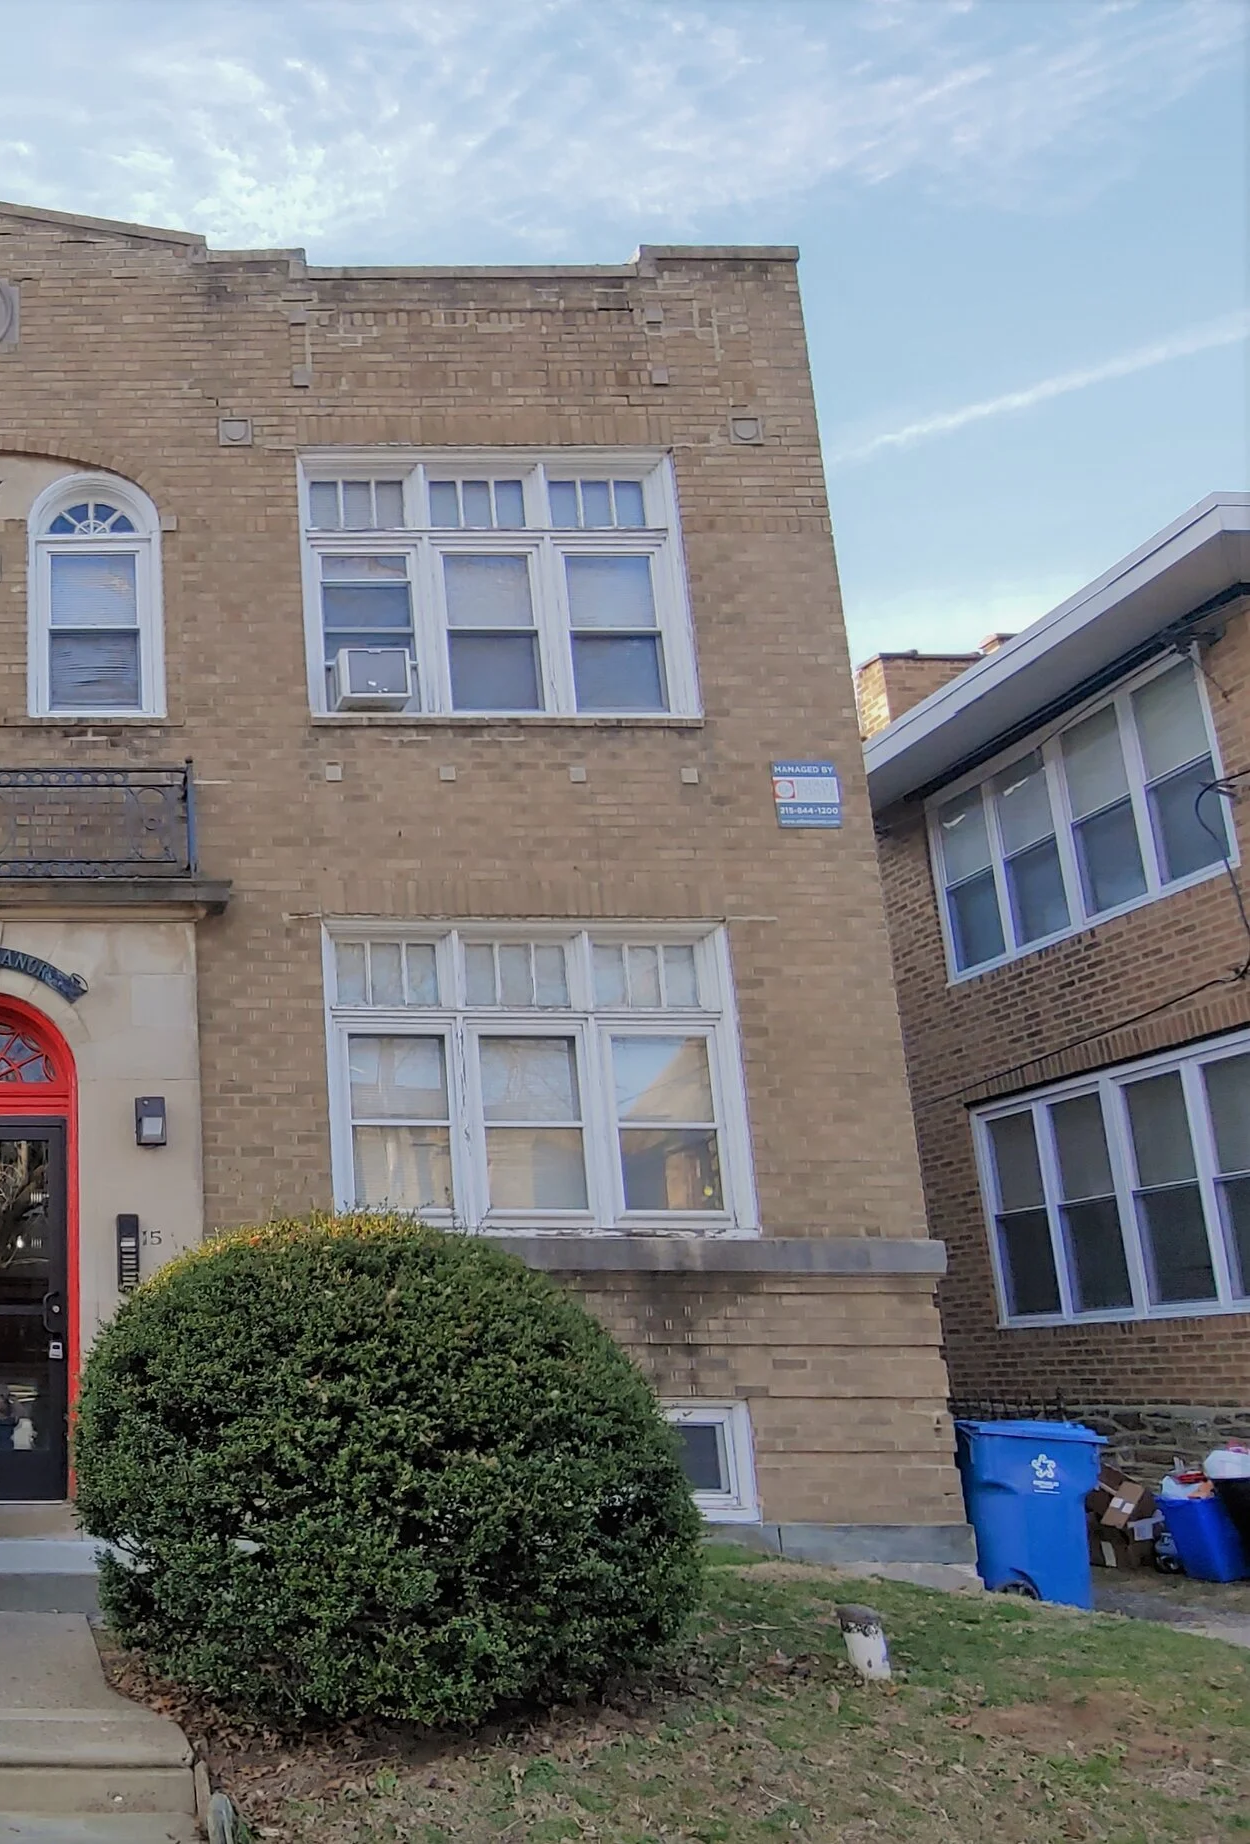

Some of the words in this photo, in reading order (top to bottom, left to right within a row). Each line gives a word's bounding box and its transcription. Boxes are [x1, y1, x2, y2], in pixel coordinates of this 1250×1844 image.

[774, 765, 819, 774] MANAGED
[821, 765, 833, 774] BY
[142, 1230, 163, 1246] 15
